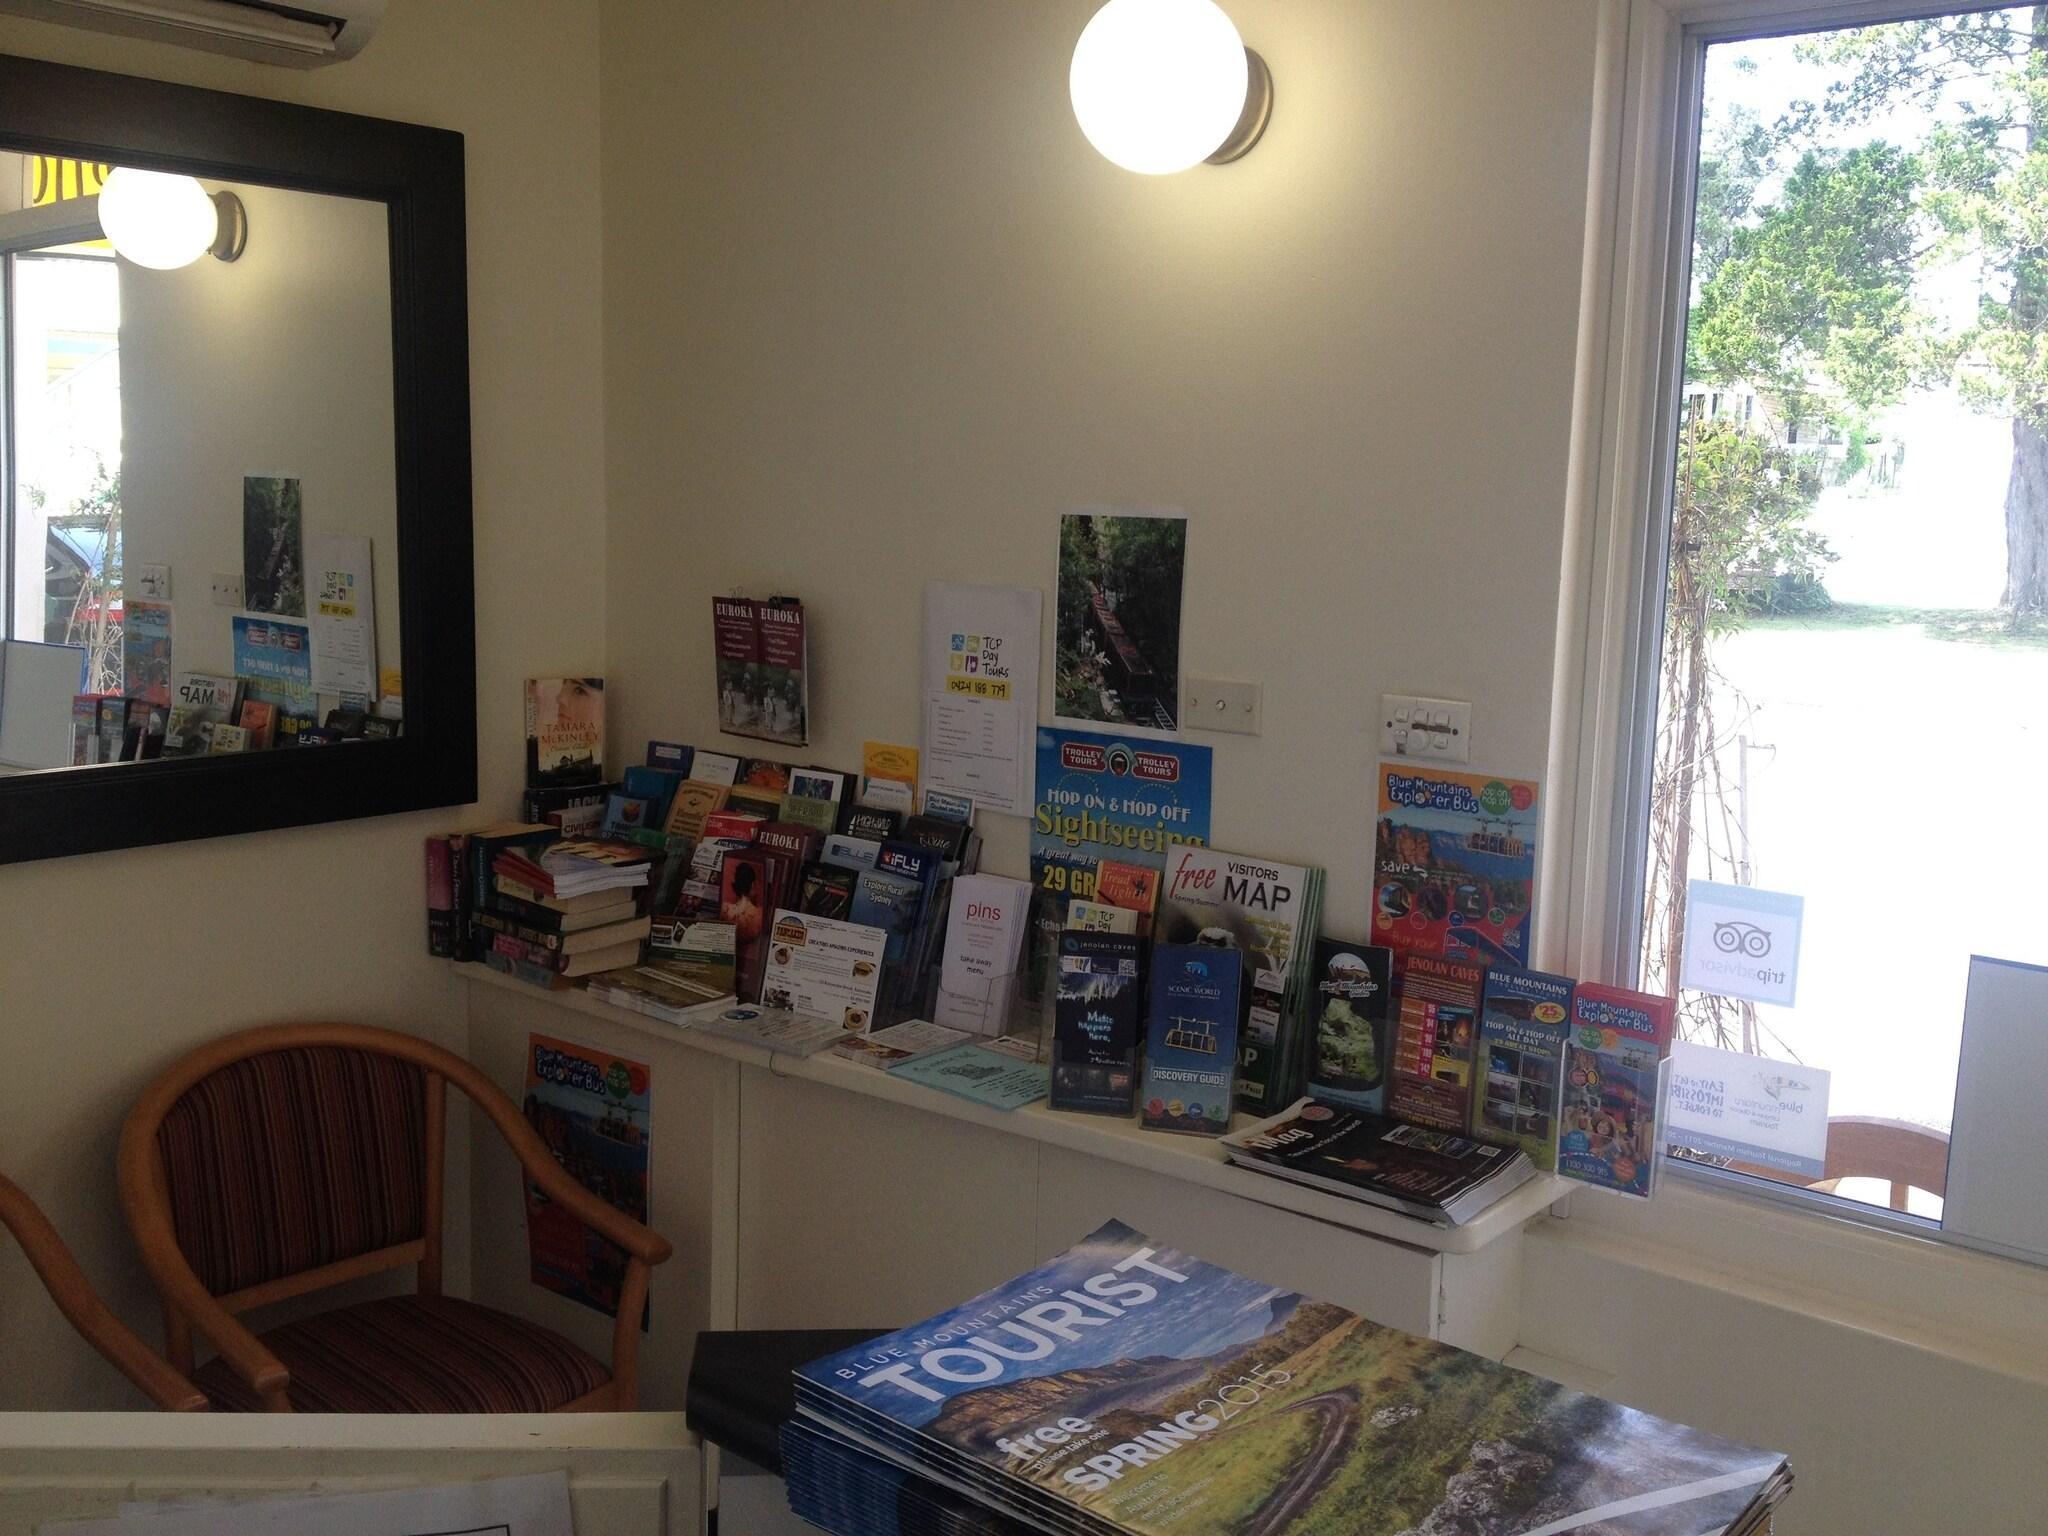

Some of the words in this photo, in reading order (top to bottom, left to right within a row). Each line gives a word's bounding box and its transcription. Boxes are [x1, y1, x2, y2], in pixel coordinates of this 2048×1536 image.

[716, 603, 753, 619] EUROKA
[760, 607, 800, 624] EUROKA
[982, 636, 1003, 650] TCP
[982, 649, 999, 667] Day
[951, 680, 971, 693] 0424
[545, 721, 596, 732] TAMARA
[1065, 747, 1103, 758] TROLLEY
[1069, 755, 1098, 766] TOURS
[1138, 757, 1175, 769] TROLLEY
[1143, 765, 1171, 776] TOURS
[1388, 774, 1412, 788] Blue
[1415, 777, 1471, 798] Mountains
[1047, 788, 1080, 806] HOP
[1084, 793, 1105, 810] ON
[1109, 798, 1120, 812] &
[1122, 799, 1156, 817] HOP
[1160, 805, 1191, 823] OFF
[1453, 796, 1479, 812] Bus
[759, 831, 801, 851] EUROKA
[890, 852, 921, 872] iFLY
[1046, 849, 1071, 861] great
[1169, 852, 1217, 899] free
[1227, 861, 1279, 882] VISITORS
[1381, 860, 1410, 874] save
[864, 877, 887, 891] Explore
[887, 883, 904, 896] Rural
[1043, 864, 1067, 892] 29
[869, 893, 892, 906] Sydney
[1223, 876, 1291, 912] MAP
[966, 901, 1001, 921] pins
[967, 966, 984, 976] menu
[1407, 957, 1448, 976] JENOLAN
[1450, 965, 1480, 981] CAVES
[1167, 984, 1193, 995] SCENIC
[1193, 986, 1222, 997] WORLD
[1489, 971, 1511, 983] BLUE
[1513, 976, 1568, 996] MOUNTAINS
[1577, 997, 1598, 1010] Blue
[1600, 1002, 1649, 1021] Mountains
[1485, 1020, 1504, 1030] HOP
[1525, 1029, 1545, 1039] HOP
[1633, 1018, 1655, 1034] Bus
[1507, 1033, 1522, 1041] ALL
[1523, 1037, 1539, 1046] DAY
[585, 1073, 606, 1095] Bus
[1153, 1069, 1198, 1084] DISCOVERY
[1199, 1072, 1226, 1086] GUIDE
[835, 1346, 905, 1380] BLUE
[918, 1284, 1055, 1349] MOUNTAINS
[856, 1247, 1190, 1404] TOURIST
[995, 1416, 1094, 1461] free
[1033, 1449, 1068, 1470] please
[1065, 1438, 1090, 1452] take
[1089, 1428, 1110, 1441] one
